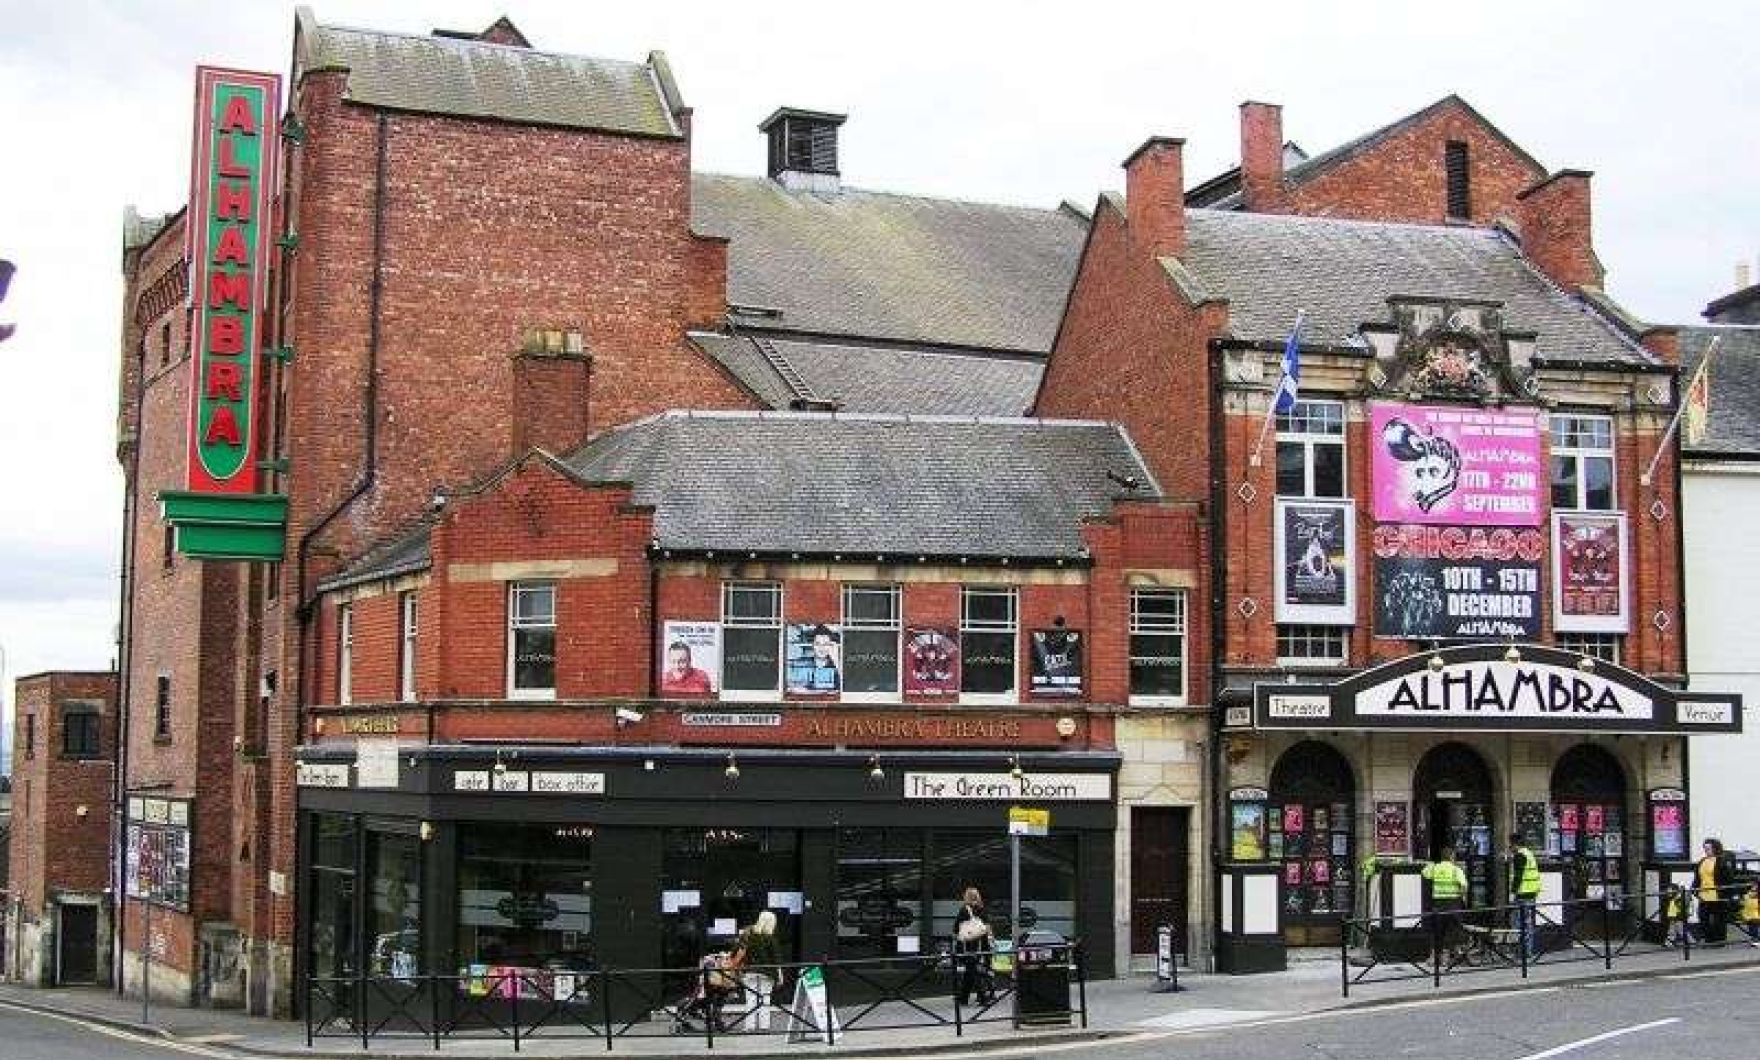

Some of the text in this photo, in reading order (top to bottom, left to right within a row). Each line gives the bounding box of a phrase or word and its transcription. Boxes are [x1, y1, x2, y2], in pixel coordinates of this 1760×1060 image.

[204, 95, 255, 445] ALHAMBRA
[1461, 493, 1536, 513] SEPTEMBER
[1372, 525, 1543, 560] CHICAGO
[1441, 566, 1483, 590] 10TH
[1497, 568, 1538, 592] 15TH
[1447, 592, 1533, 617] DECEMBER
[1387, 665, 1624, 714] ALHAMBRA
[1272, 697, 1327, 716] Theatre
[1684, 703, 1725, 722] Venue
[683, 714, 778, 726] CANMORE STREET
[807, 719, 1020, 738] ALHAMBRA THEATRE
[536, 774, 599, 792] box office
[910, 774, 1077, 797] The Green Room
